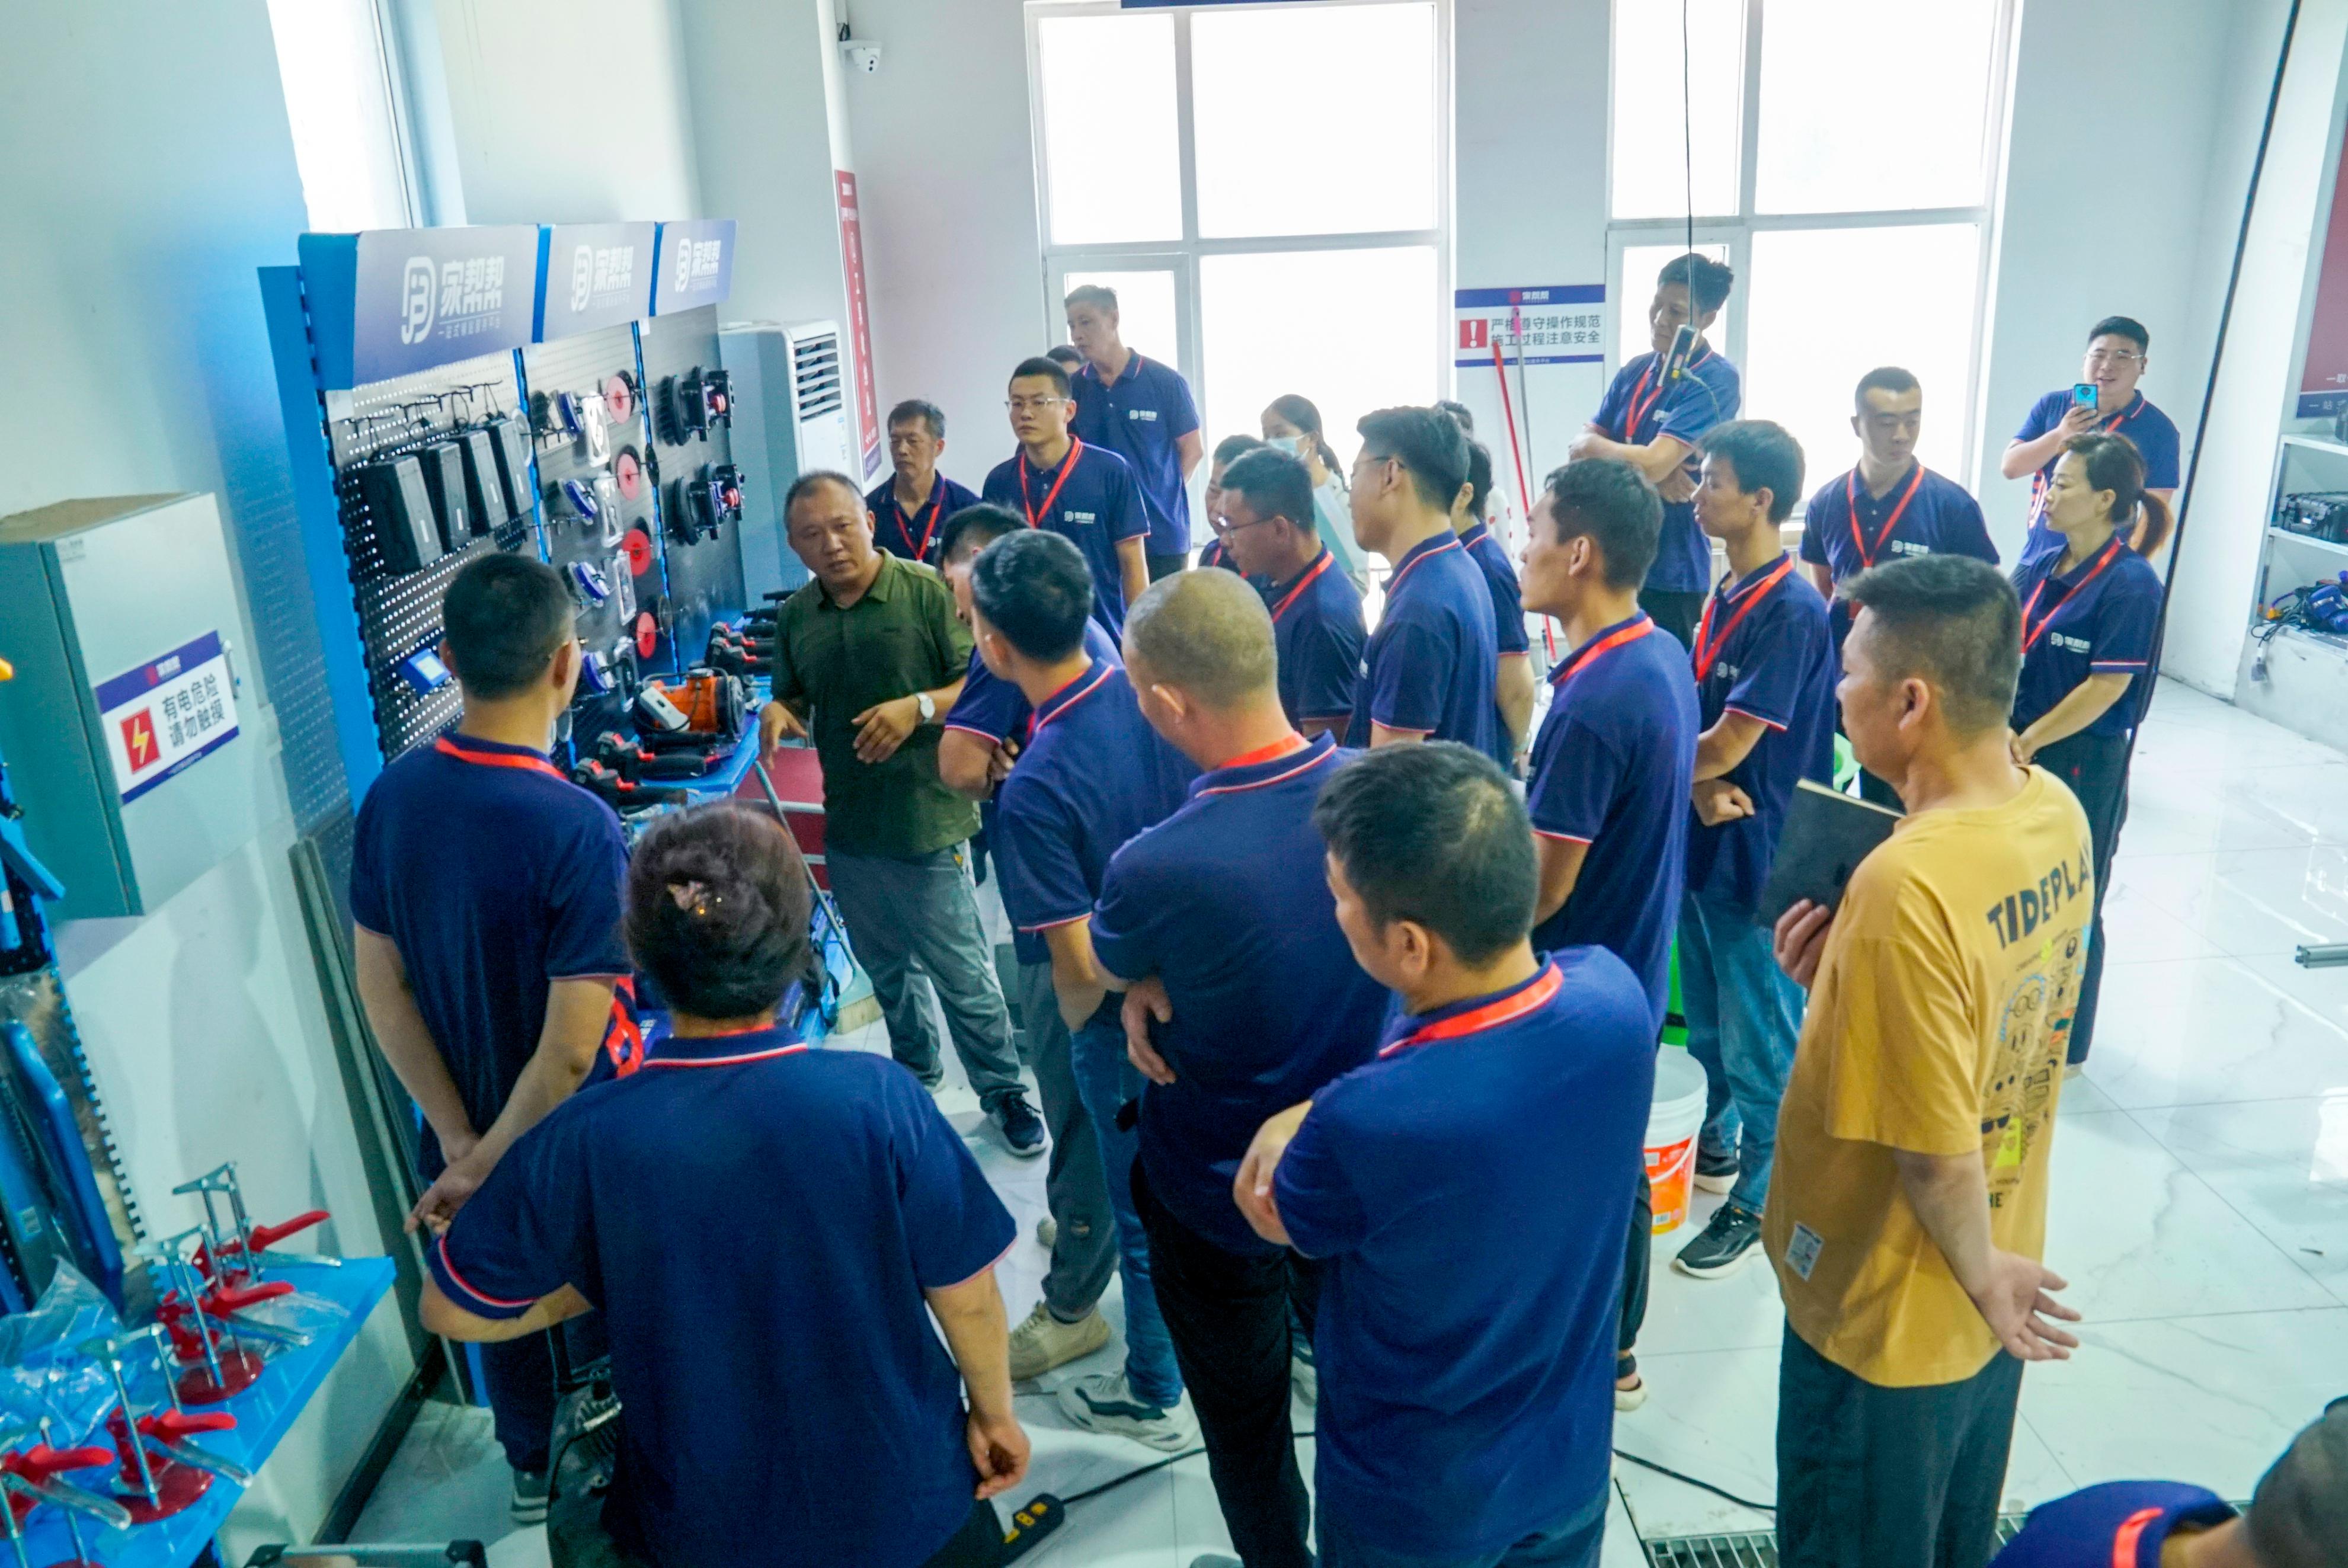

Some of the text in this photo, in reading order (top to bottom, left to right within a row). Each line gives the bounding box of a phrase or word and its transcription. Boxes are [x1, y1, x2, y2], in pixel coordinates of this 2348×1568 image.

[440, 255, 504, 317] 家帮帮
[594, 245, 634, 290] 家帮帮
[1491, 331, 1600, 346] 施工过程注意安全
[162, 673, 220, 722] 有电危险
[168, 698, 225, 748] 请勿触摸
[1986, 840, 2090, 950] TIDEPLA
